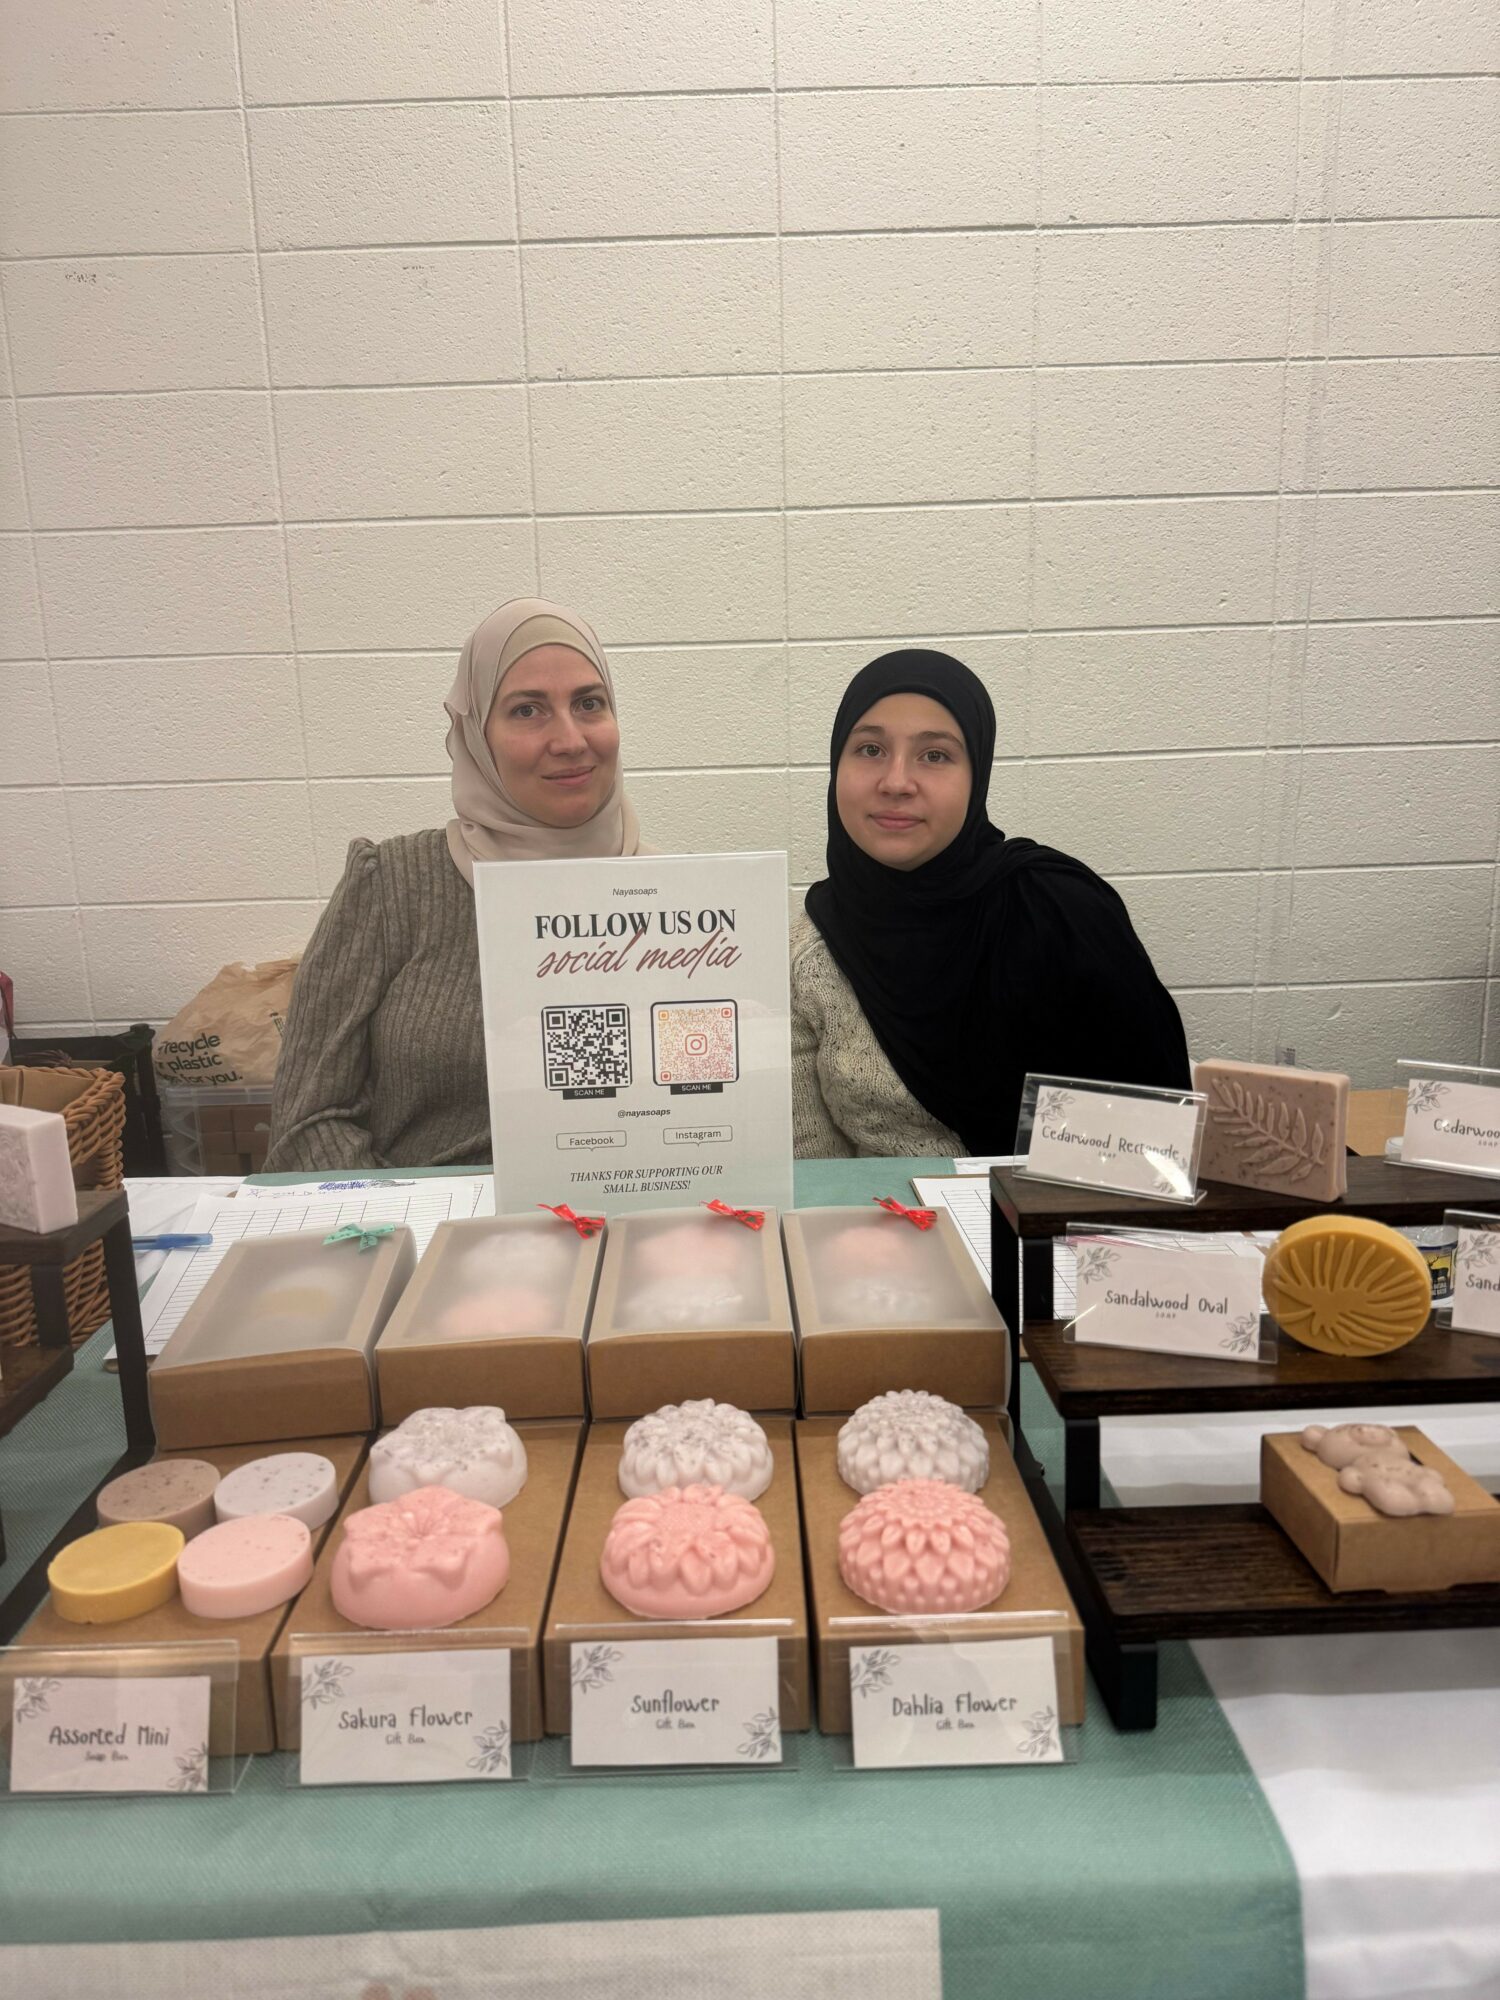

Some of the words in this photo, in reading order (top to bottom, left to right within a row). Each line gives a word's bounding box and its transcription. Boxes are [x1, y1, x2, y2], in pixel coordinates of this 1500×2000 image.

[612, 887, 658, 897] Nayasoaps
[535, 912, 652, 939] FOLLOW
[658, 910, 692, 935] US
[697, 908, 736, 934] ON
[536, 927, 645, 978] social
[635, 927, 742, 979] media
[168, 1051, 222, 1073] plastic
[206, 1070, 243, 1086] you.
[681, 1084, 701, 1092] SCAN
[702, 1083, 712, 1091] ME
[573, 1089, 595, 1097] SCAN
[595, 1088, 606, 1096] ME
[617, 1108, 671, 1119] @nayasoaps
[569, 1136, 614, 1147] Facebook
[675, 1130, 722, 1141] Instagram
[1041, 1125, 1111, 1149] Cedarwood
[570, 1170, 612, 1182] THANKS
[613, 1169, 634, 1180] FOR
[634, 1166, 700, 1178] SUPPORTING
[701, 1165, 723, 1176] OUR
[603, 1182, 639, 1194] SMALL
[640, 1180, 691, 1192] BUSINESS!
[1104, 1289, 1189, 1311] Sandalwood
[1198, 1297, 1228, 1315] Oval
[631, 1689, 720, 1714] Sunflower
[892, 1693, 944, 1717] Dahlia
[955, 1691, 1018, 1714] Flower
[338, 1707, 397, 1730] Sakura
[409, 1704, 473, 1727] Flower
[48, 1722, 127, 1746] Assorted
[137, 1725, 170, 1746] Mini
